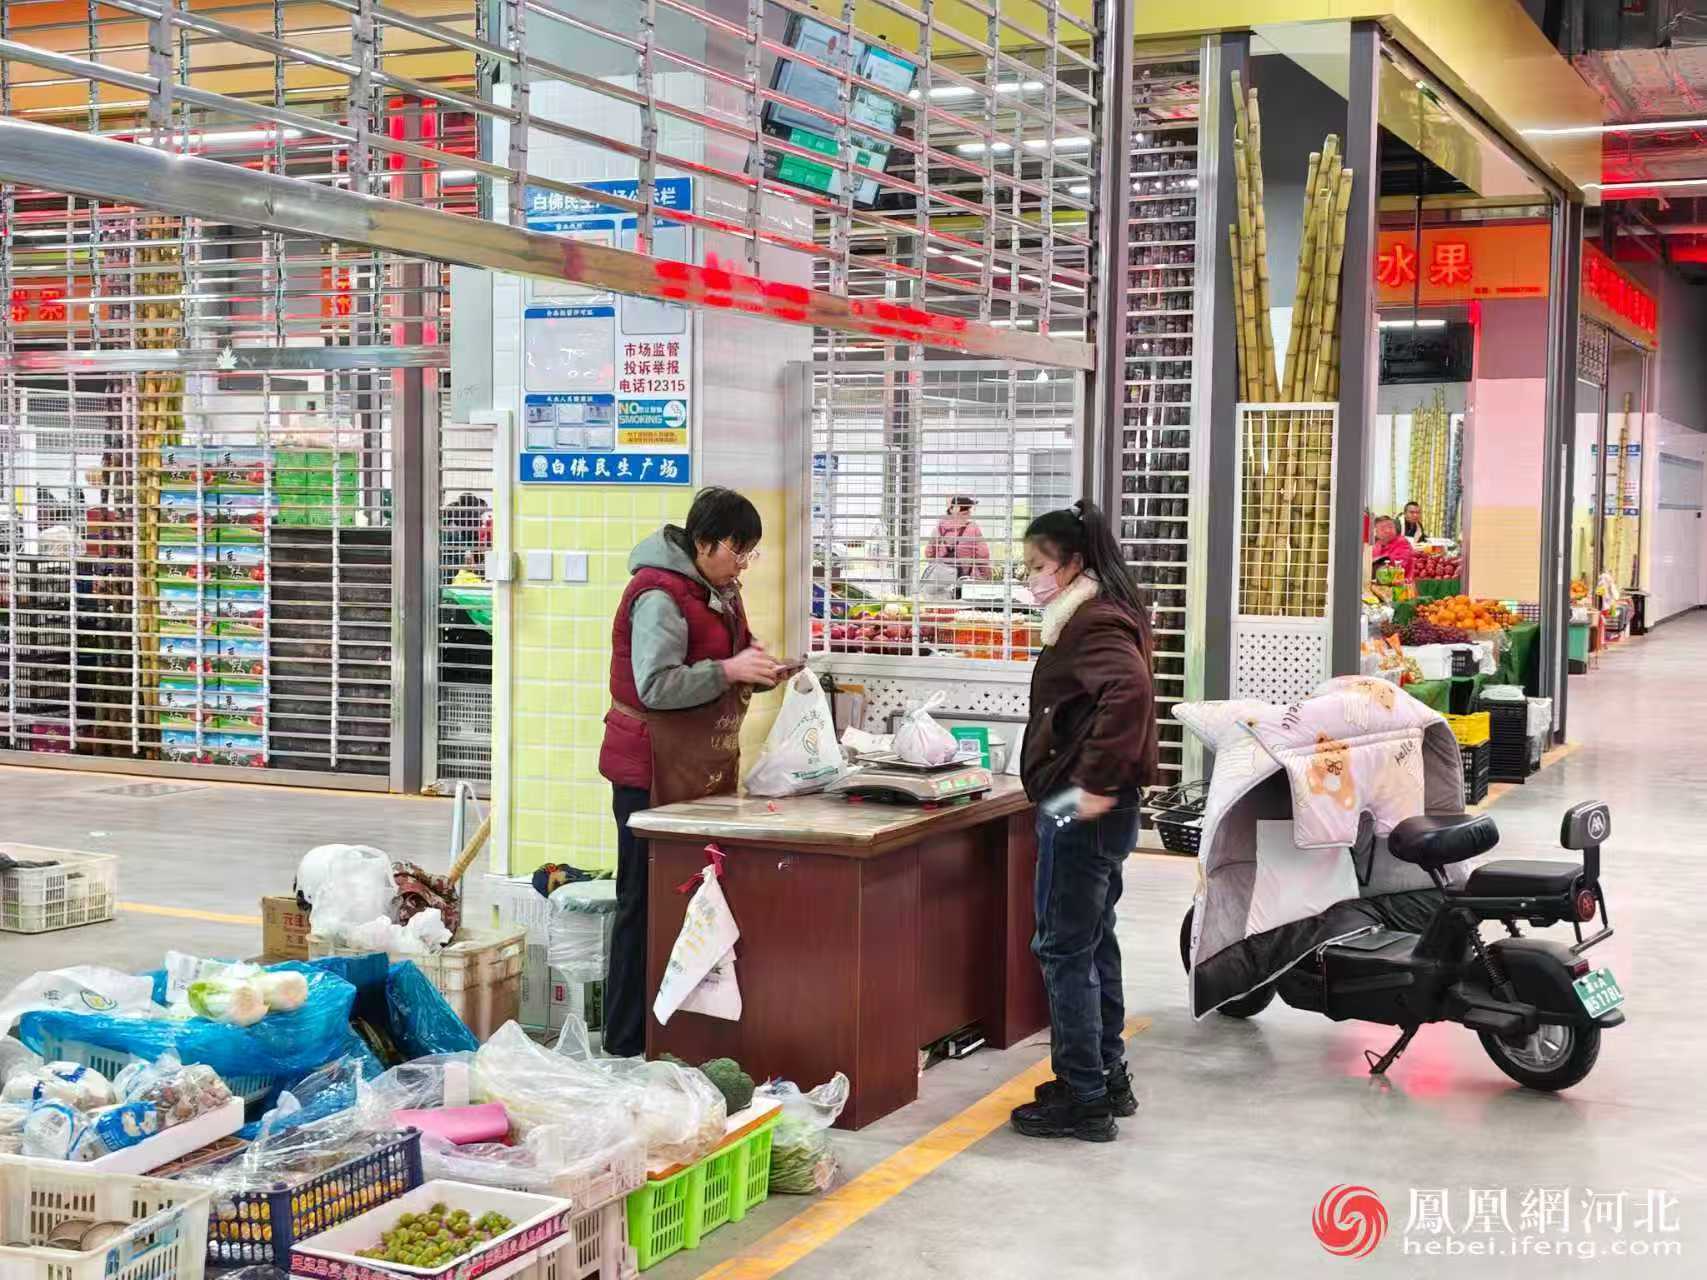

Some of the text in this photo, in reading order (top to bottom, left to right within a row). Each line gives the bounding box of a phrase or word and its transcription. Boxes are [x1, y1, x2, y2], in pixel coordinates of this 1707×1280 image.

[1377, 242, 1472, 287] 水果
[624, 342, 680, 357] 市场监管
[624, 360, 680, 375] 投诉举报
[619, 378, 686, 393] 电话12315
[618, 402, 640, 415] NO
[618, 415, 663, 425] SMOKING
[551, 456, 679, 481] 白佛民生广场
